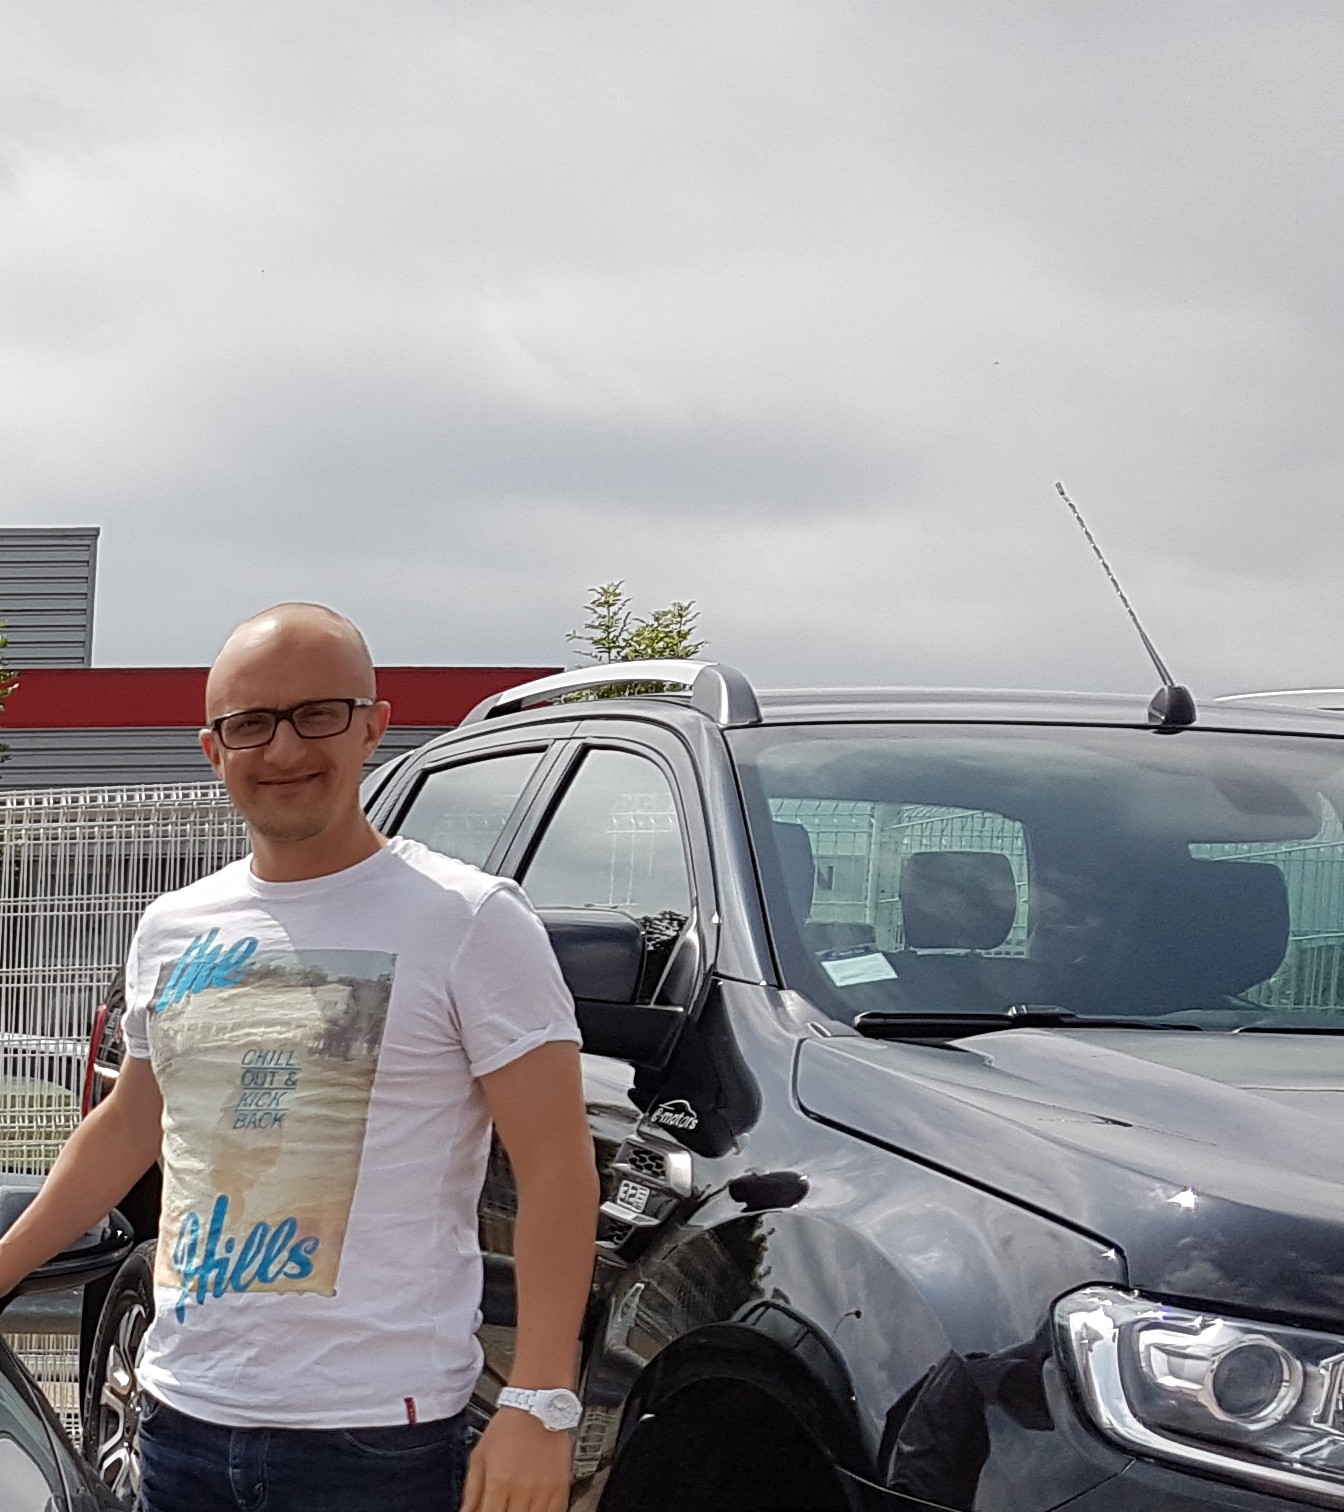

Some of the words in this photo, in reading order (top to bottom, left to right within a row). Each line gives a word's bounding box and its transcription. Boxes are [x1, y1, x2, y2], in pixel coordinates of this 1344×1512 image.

[241, 1048, 295, 1066] CHILL
[241, 1069, 278, 1087] OUT
[284, 1071, 298, 1087] &
[236, 1091, 288, 1107] KICK
[233, 1112, 287, 1129] BACK
[173, 1194, 320, 1324] Hills
